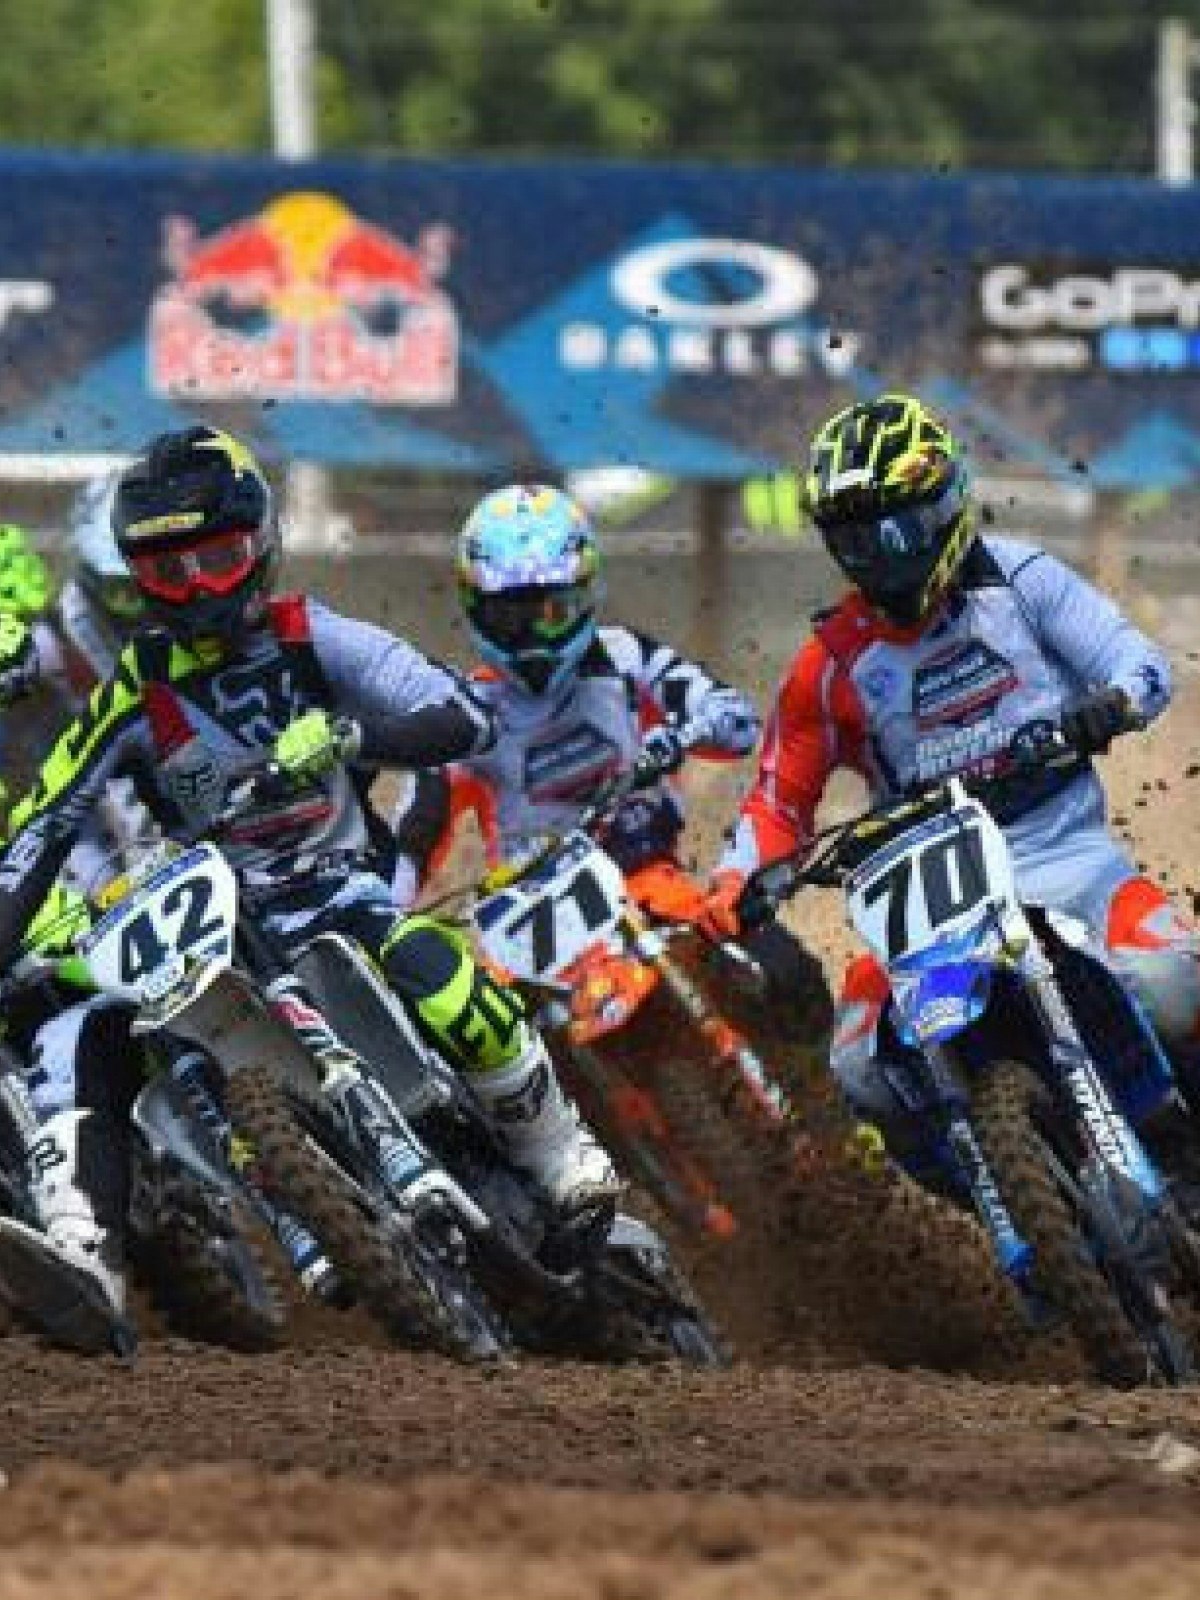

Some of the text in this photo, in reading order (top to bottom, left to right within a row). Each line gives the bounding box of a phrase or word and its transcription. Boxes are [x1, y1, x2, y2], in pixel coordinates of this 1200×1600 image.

[120, 874, 228, 986] 42
[505, 867, 614, 975] 71
[863, 824, 990, 957] 70
